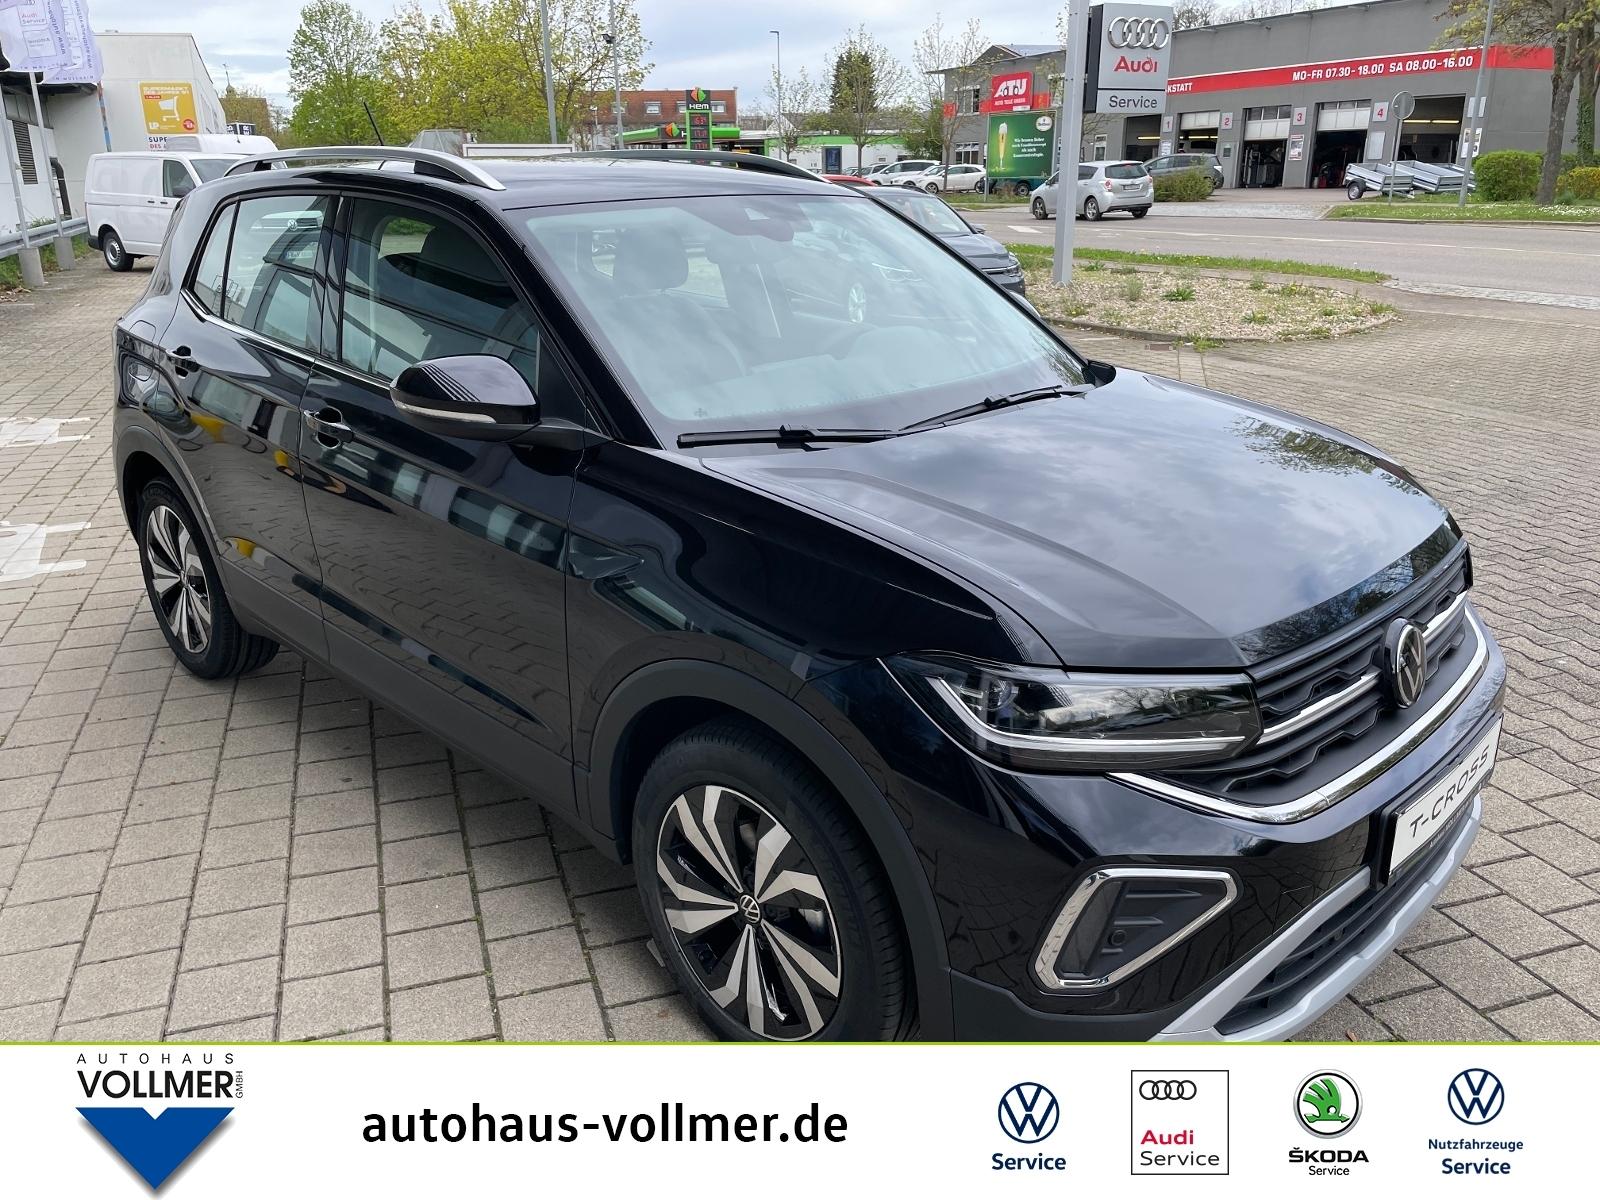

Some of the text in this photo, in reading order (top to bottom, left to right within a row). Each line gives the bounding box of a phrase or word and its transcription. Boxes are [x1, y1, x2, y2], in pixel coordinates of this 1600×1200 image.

[1114, 55, 1157, 72] Audi
[1293, 69, 1323, 80] MO-FR
[1389, 62, 1404, 73] SA
[1165, 82, 1193, 93] KSTATT
[1109, 96, 1157, 109] Service
[1297, 113, 1303, 122] 3
[1377, 108, 1384, 117] 4
[1225, 118, 1230, 126] 2
[1410, 745, 1489, 838] T-CROSS
